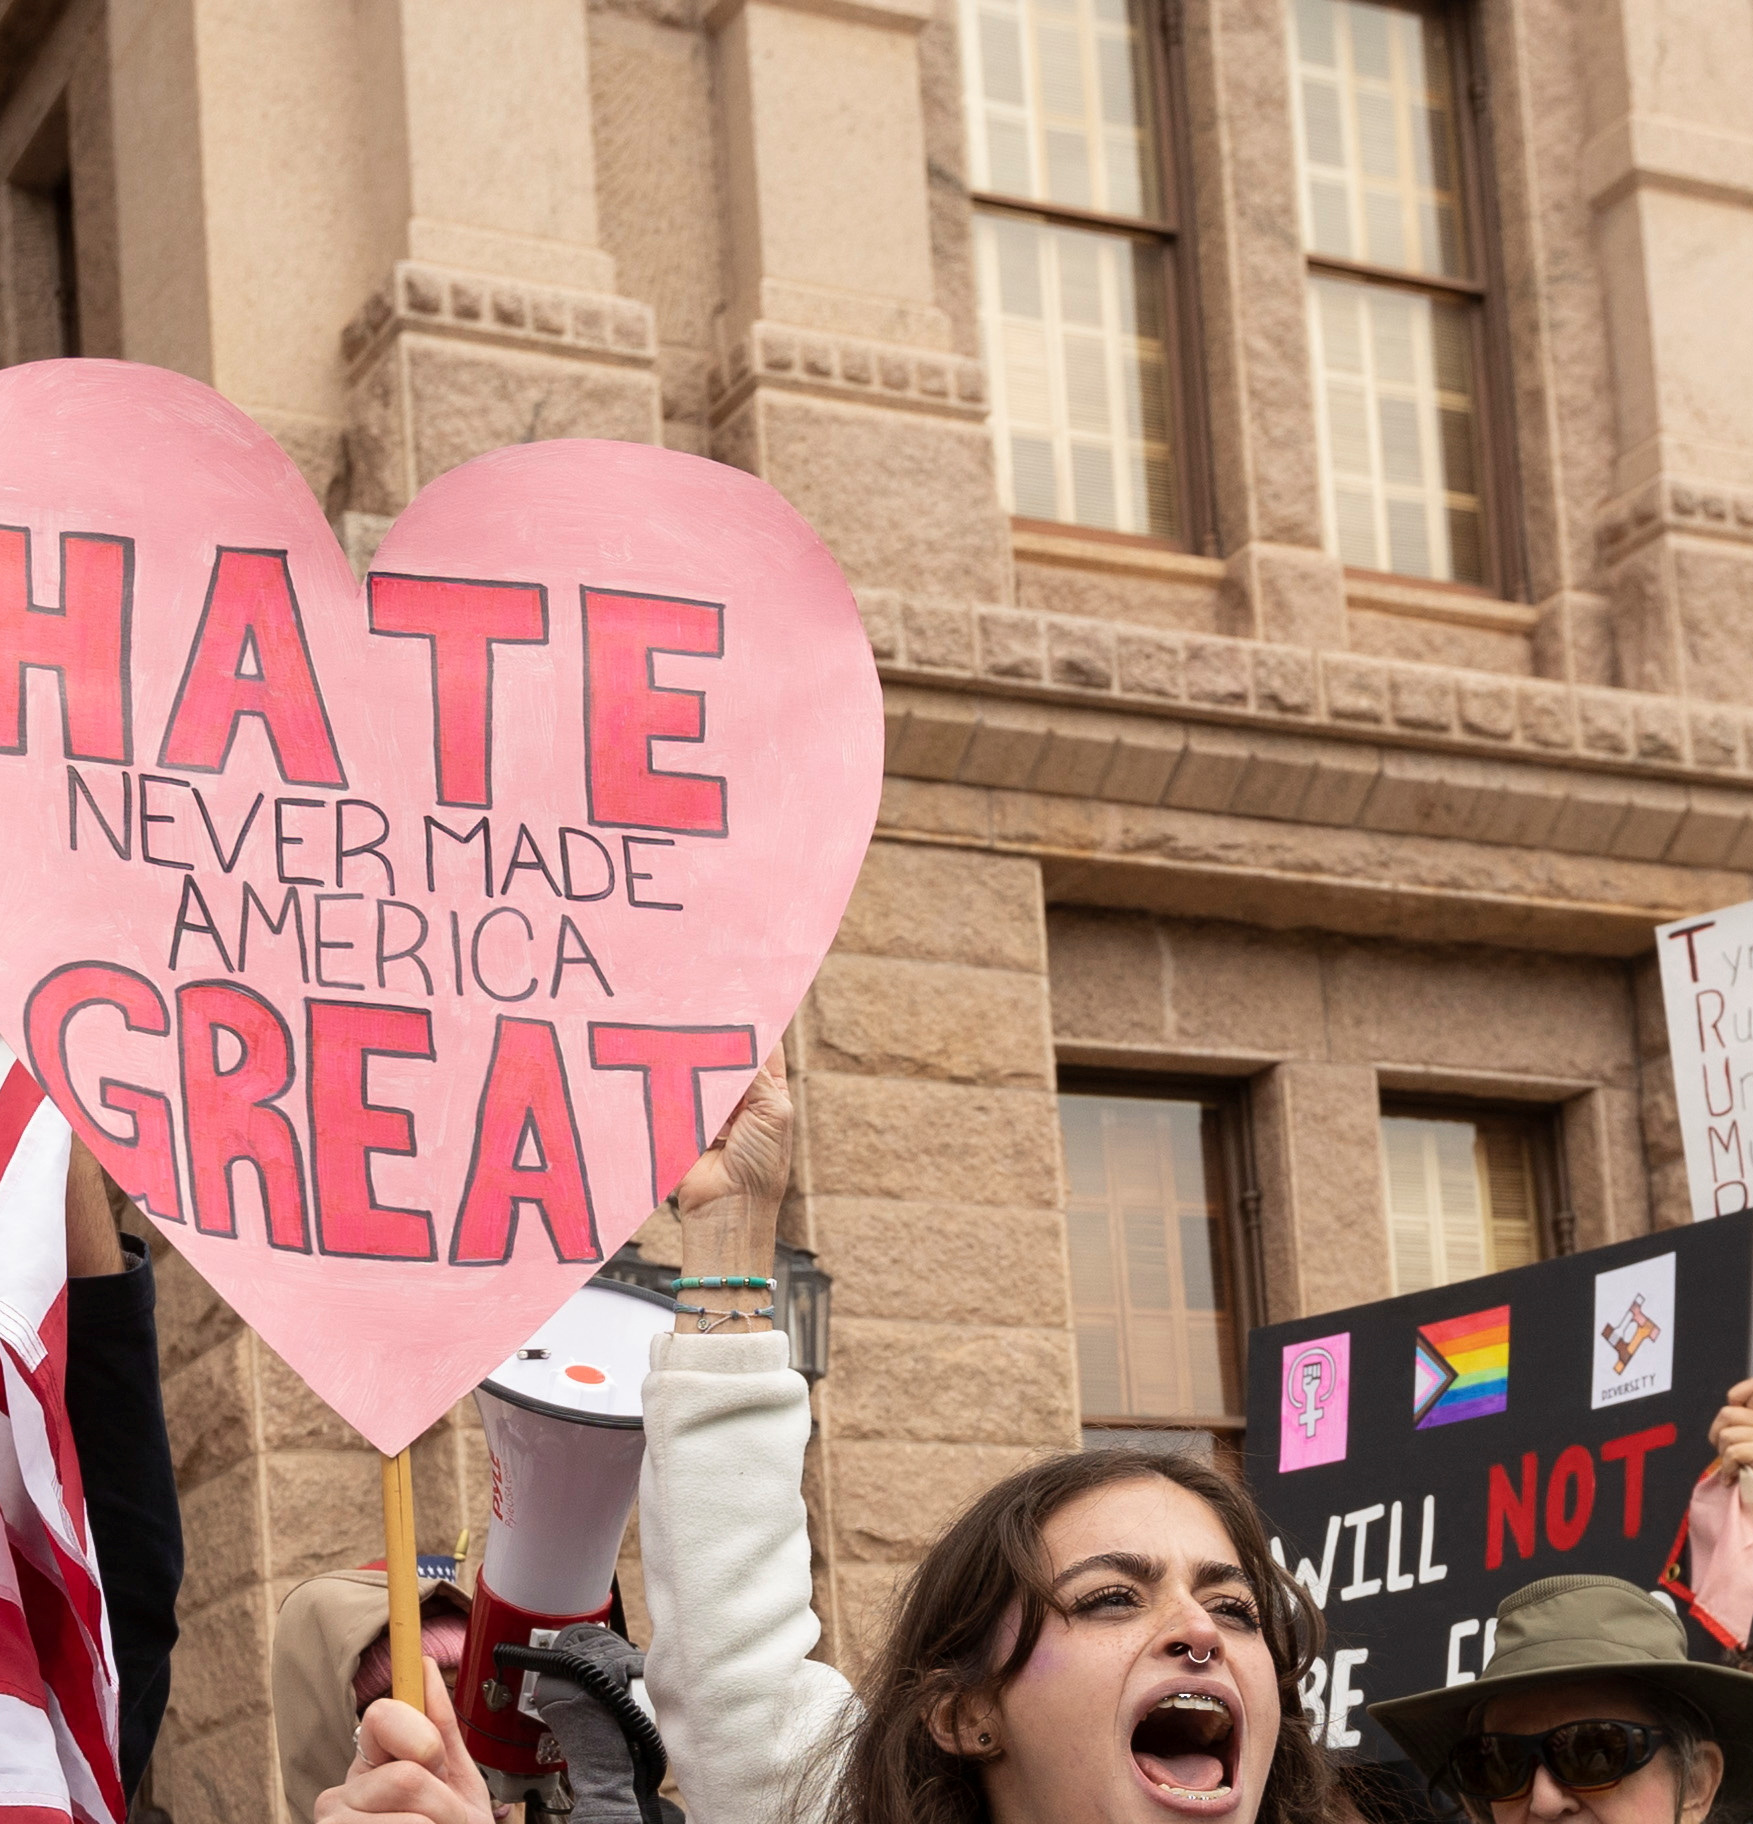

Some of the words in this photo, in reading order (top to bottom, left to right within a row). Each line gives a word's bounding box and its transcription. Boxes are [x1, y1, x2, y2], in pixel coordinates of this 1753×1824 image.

[67, 766, 395, 895] NEVER
[425, 815, 683, 910] MADE
[169, 875, 614, 1000] AMERICA
[24, 960, 756, 1265] GREAT
[1602, 1374, 1656, 1401] DIVERSITY
[1270, 1495, 1447, 1610] WILL
[1485, 1422, 1677, 1570] NOT
